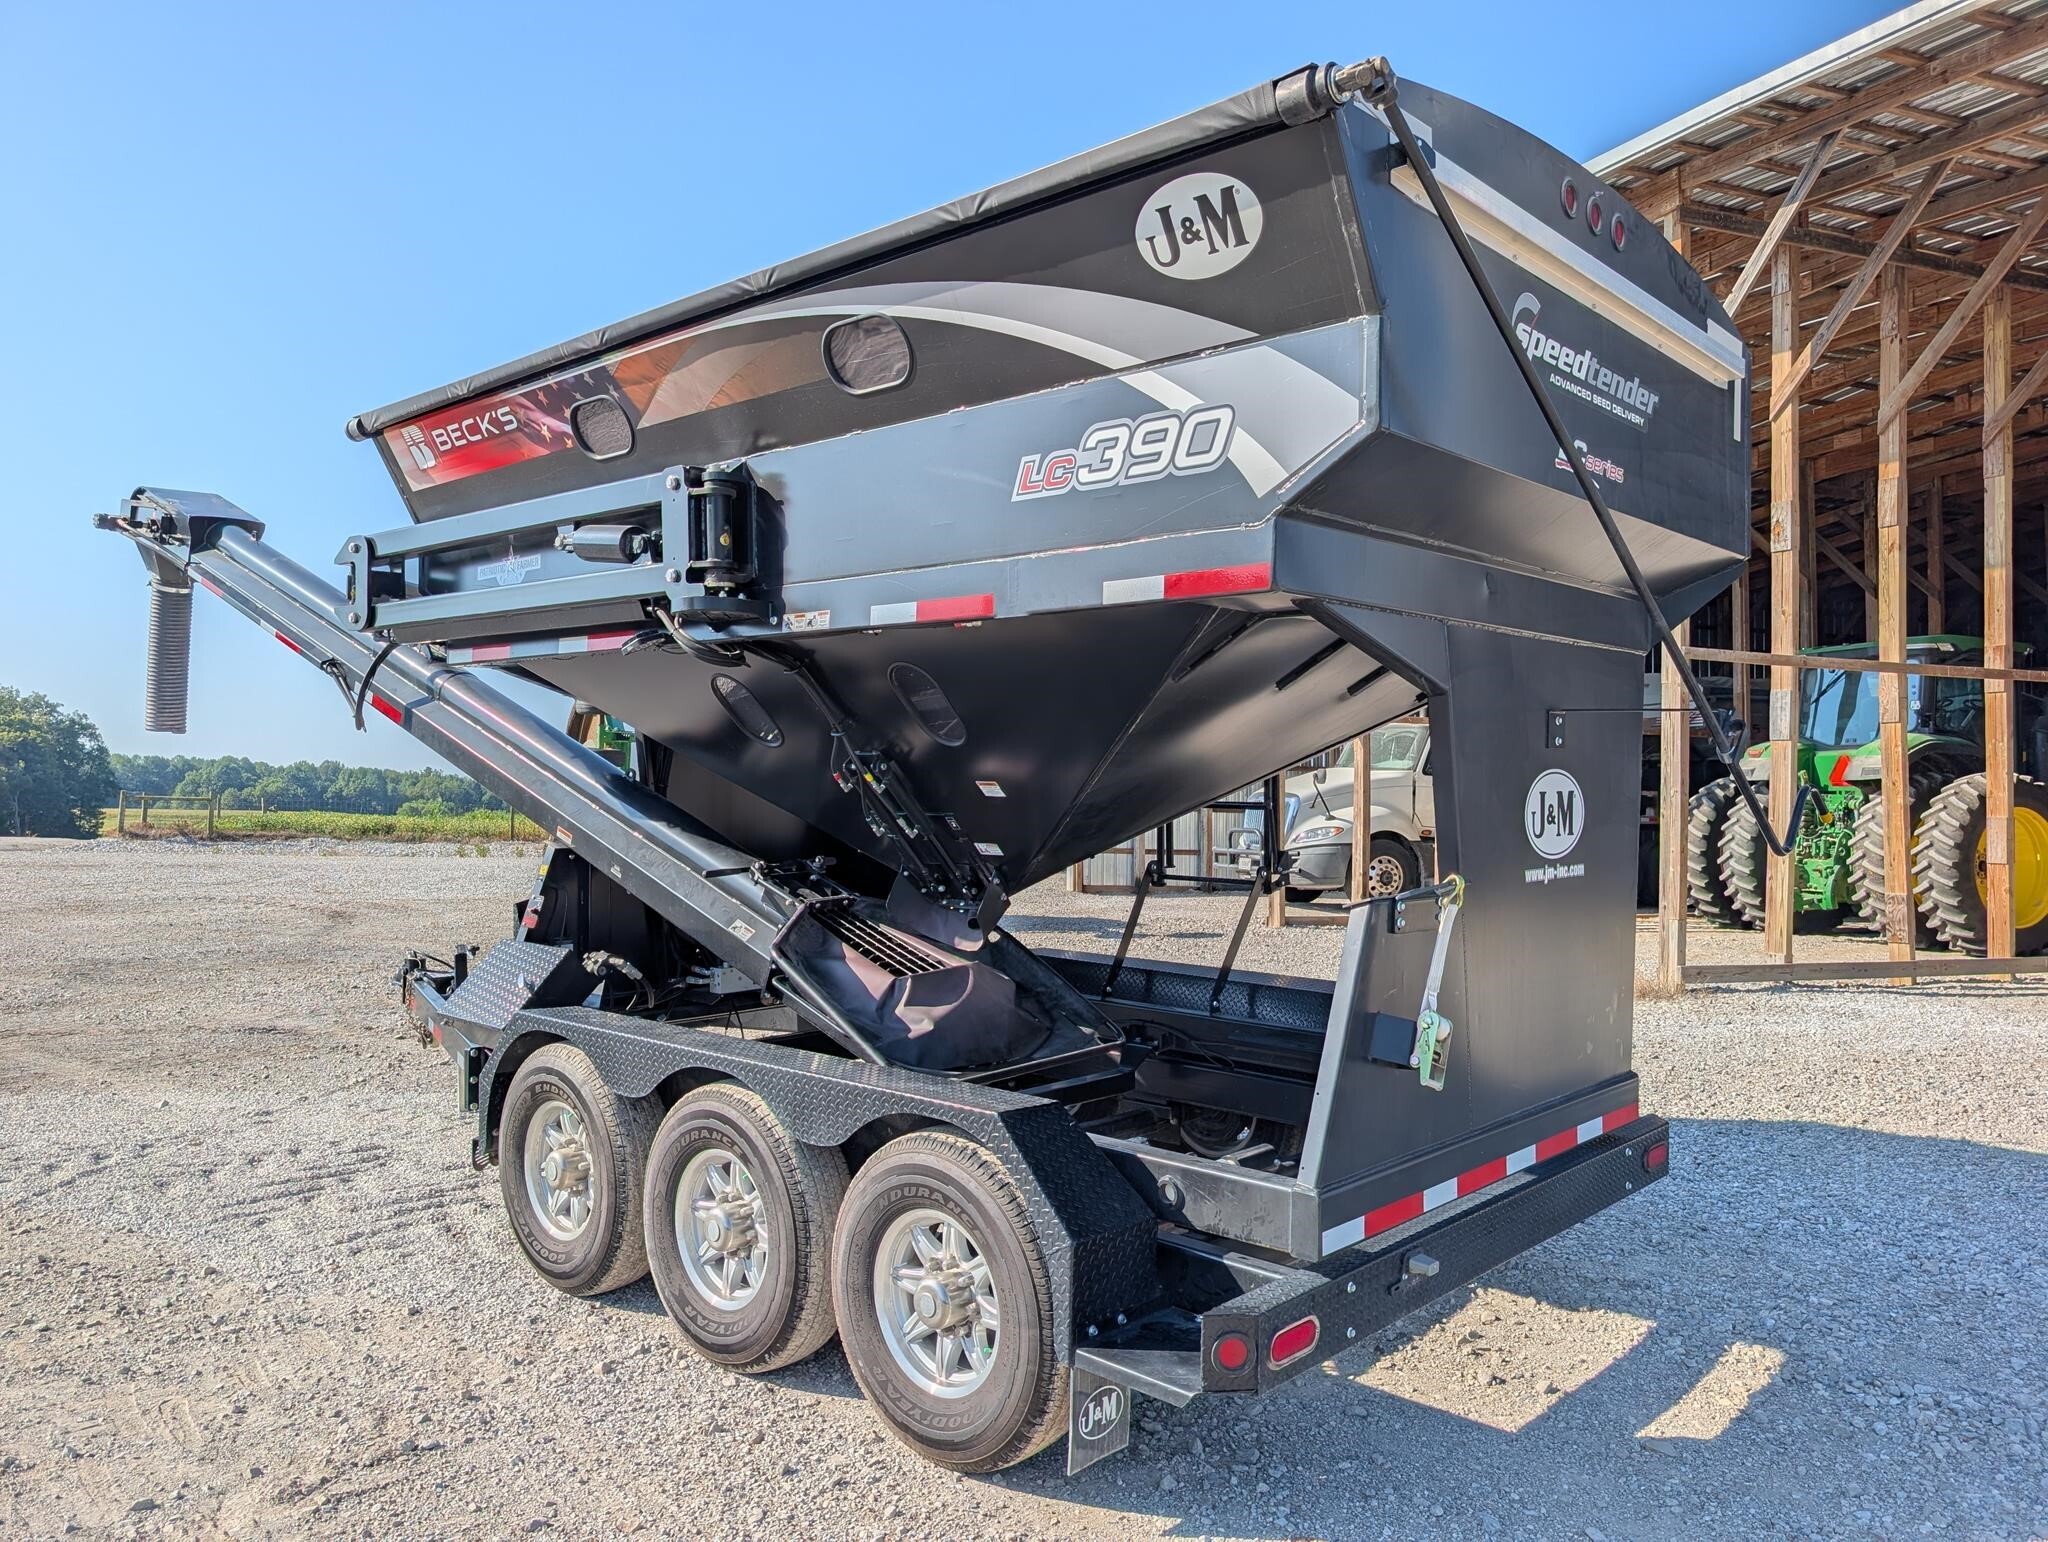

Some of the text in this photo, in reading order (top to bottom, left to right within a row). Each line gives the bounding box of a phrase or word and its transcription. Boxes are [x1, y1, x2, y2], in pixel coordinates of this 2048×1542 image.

[1145, 185, 1250, 268] J&M
[1550, 373, 1645, 427] ADVANCED SEED DELIVERY
[431, 406, 518, 452] BECK'S
[1531, 790, 1575, 839] J&M
[1524, 863, 1585, 885] www.jm-inc.com
[1081, 1391, 1118, 1433] J&M
